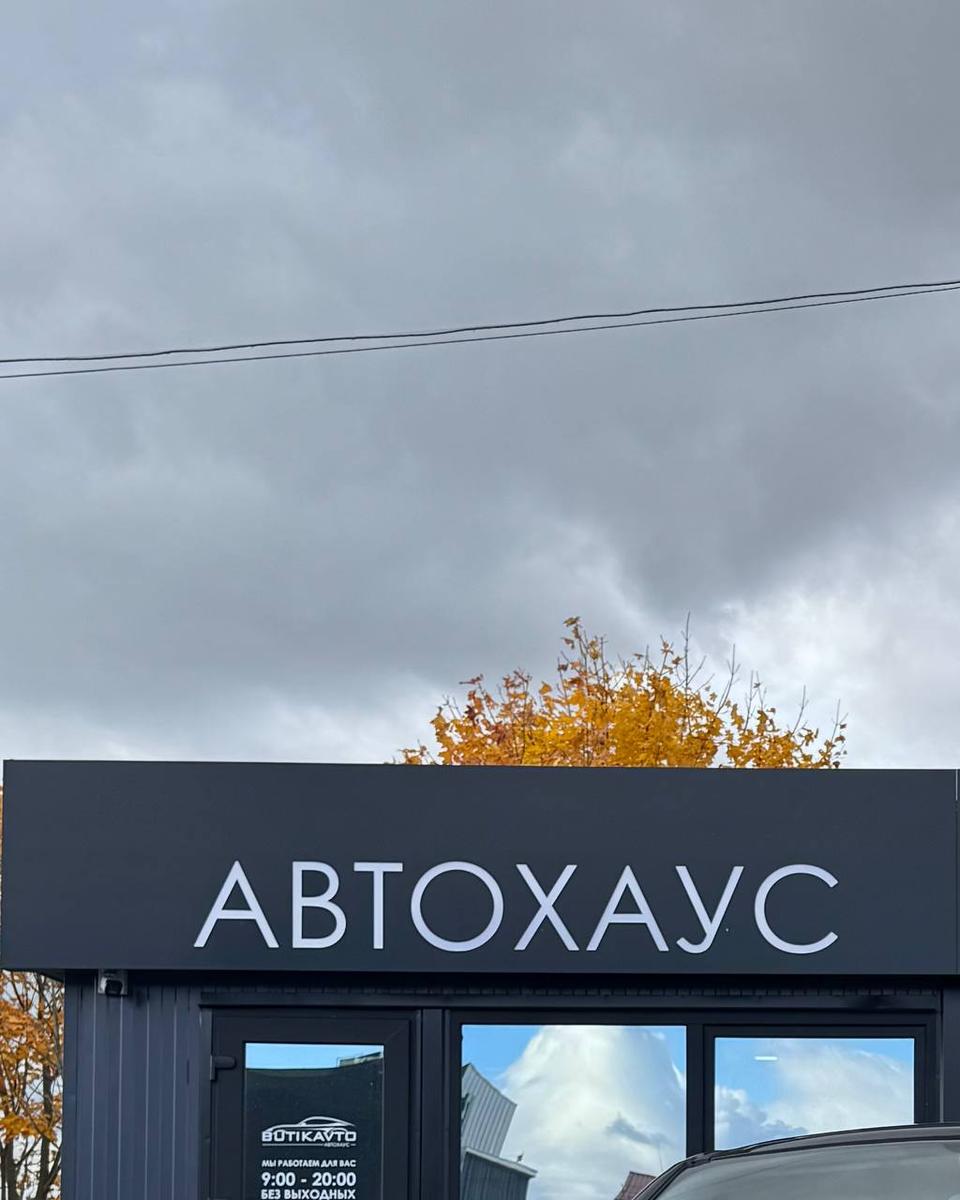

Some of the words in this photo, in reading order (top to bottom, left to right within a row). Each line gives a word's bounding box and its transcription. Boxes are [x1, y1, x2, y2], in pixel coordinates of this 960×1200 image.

[194, 860, 838, 954] АВТОХАУС
[261, 1130, 357, 1142] BUTIKAVTO
[261, 1159, 276, 1168] МЫ
[278, 1159, 320, 1168] РАБОТАЕМ
[321, 1159, 338, 1168] ДЛЯ
[339, 1159, 357, 1168] ВАС
[261, 1172, 296, 1187] 9:00
[312, 1172, 357, 1187] 20:00
[261, 1189, 281, 1200] БЕЗ
[284, 1189, 356, 1200] ВЫХОДНЫХ
